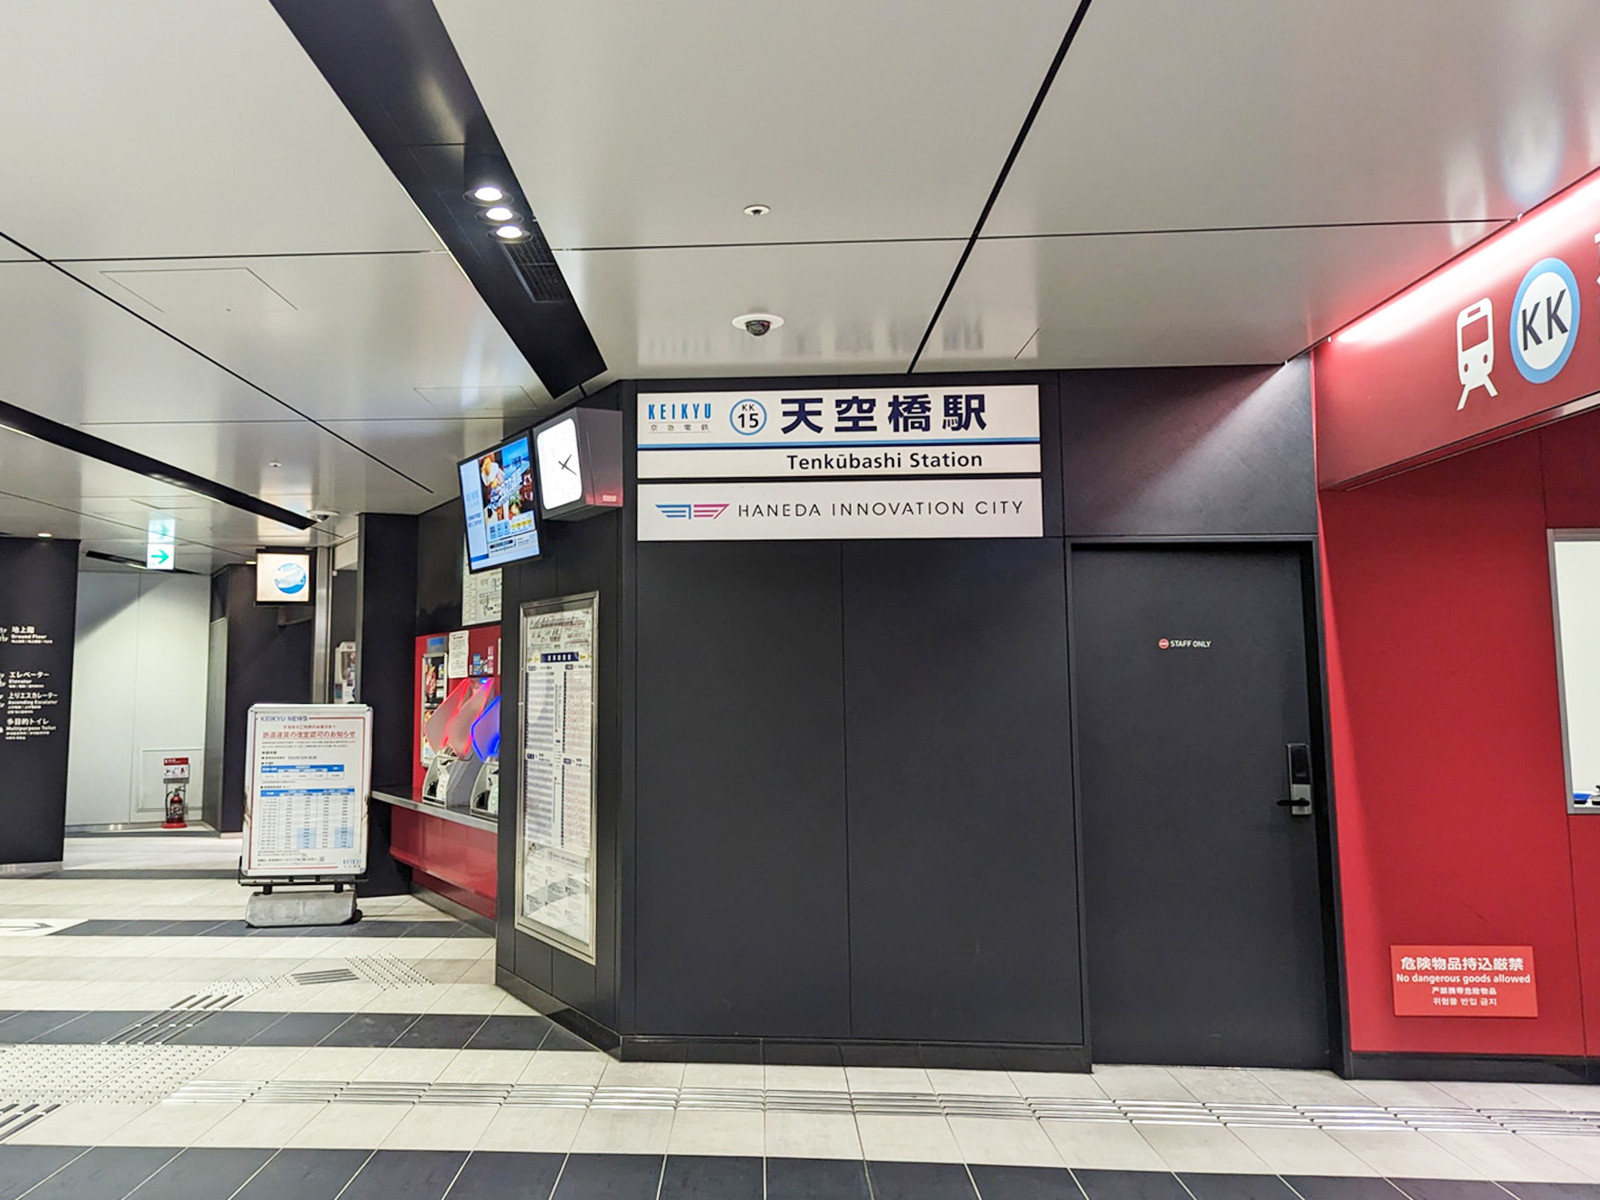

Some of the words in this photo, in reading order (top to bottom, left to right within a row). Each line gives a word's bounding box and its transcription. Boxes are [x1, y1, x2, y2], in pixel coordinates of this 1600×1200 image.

[1521, 288, 1569, 352] KK
[648, 402, 712, 420] KEIKYU
[741, 404, 755, 412] KK
[780, 394, 987, 435] 天空橋駅
[650, 423, 709, 432] 京急電鉄
[737, 413, 759, 429] 15
[787, 453, 901, 470] Tenkūbashi
[910, 451, 982, 468] Station
[738, 503, 821, 518] HANEDA
[832, 501, 964, 516] INNOVATION
[975, 500, 1023, 515] CITY
[1170, 640, 1192, 648] STAFF
[1192, 640, 1212, 648] ONLY
[9, 671, 50, 679] エレベーター
[8, 691, 58, 699] 上りエスカレーター
[7, 718, 49, 726] 多目的トイレ
[1400, 956, 1524, 971] 危険物品持込厳禁
[1396, 973, 1410, 983] No
[1411, 973, 1461, 985] dangerous
[1462, 973, 1491, 985] goods
[1493, 973, 1531, 984] allowed
